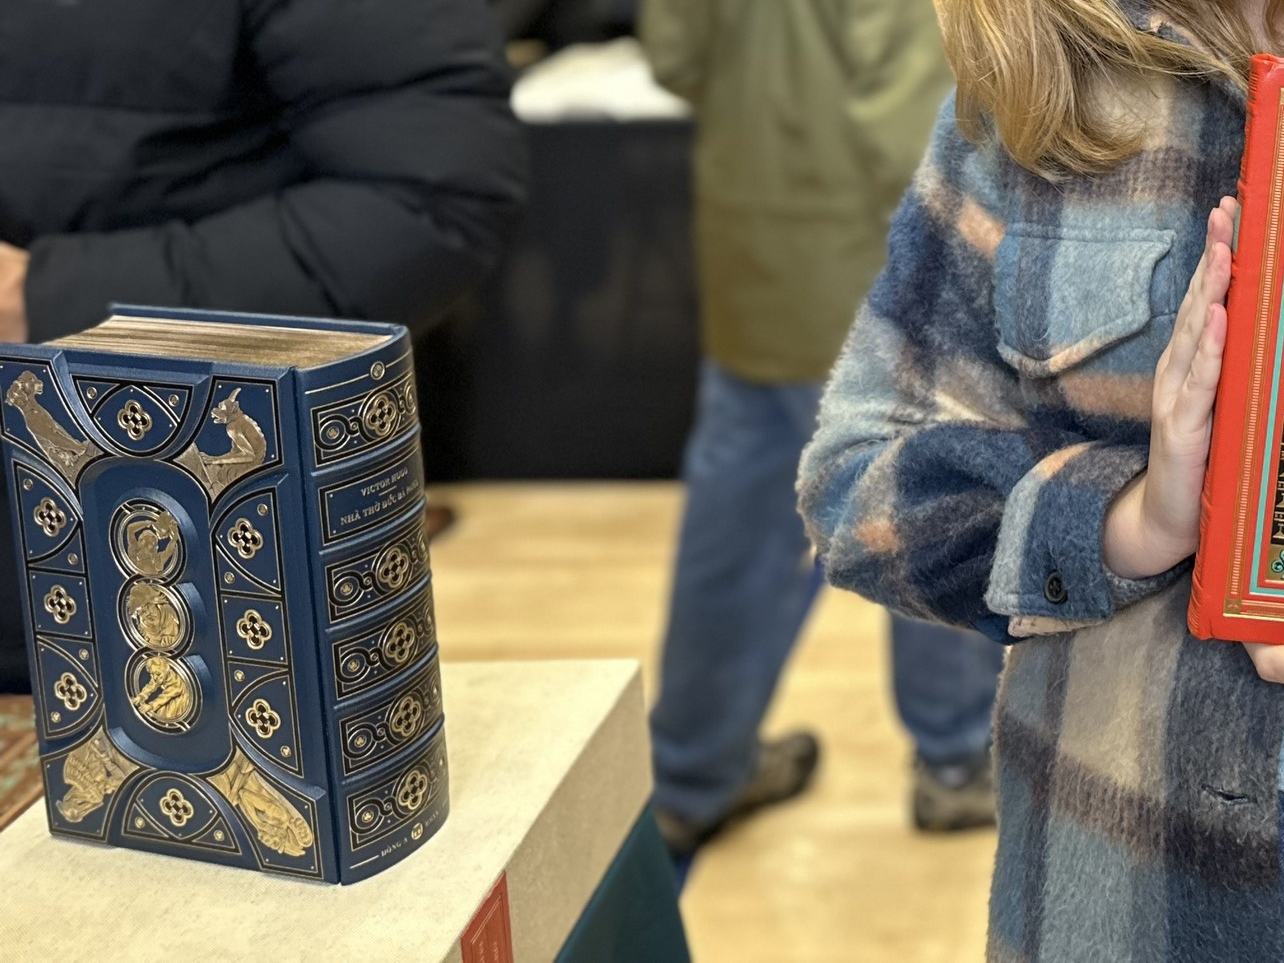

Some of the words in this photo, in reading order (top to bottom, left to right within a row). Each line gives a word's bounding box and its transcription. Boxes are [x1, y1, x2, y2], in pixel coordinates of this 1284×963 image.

[360, 478, 391, 497] VICTOR
[391, 467, 409, 483] HUGO
[340, 510, 361, 526] NHÀ
